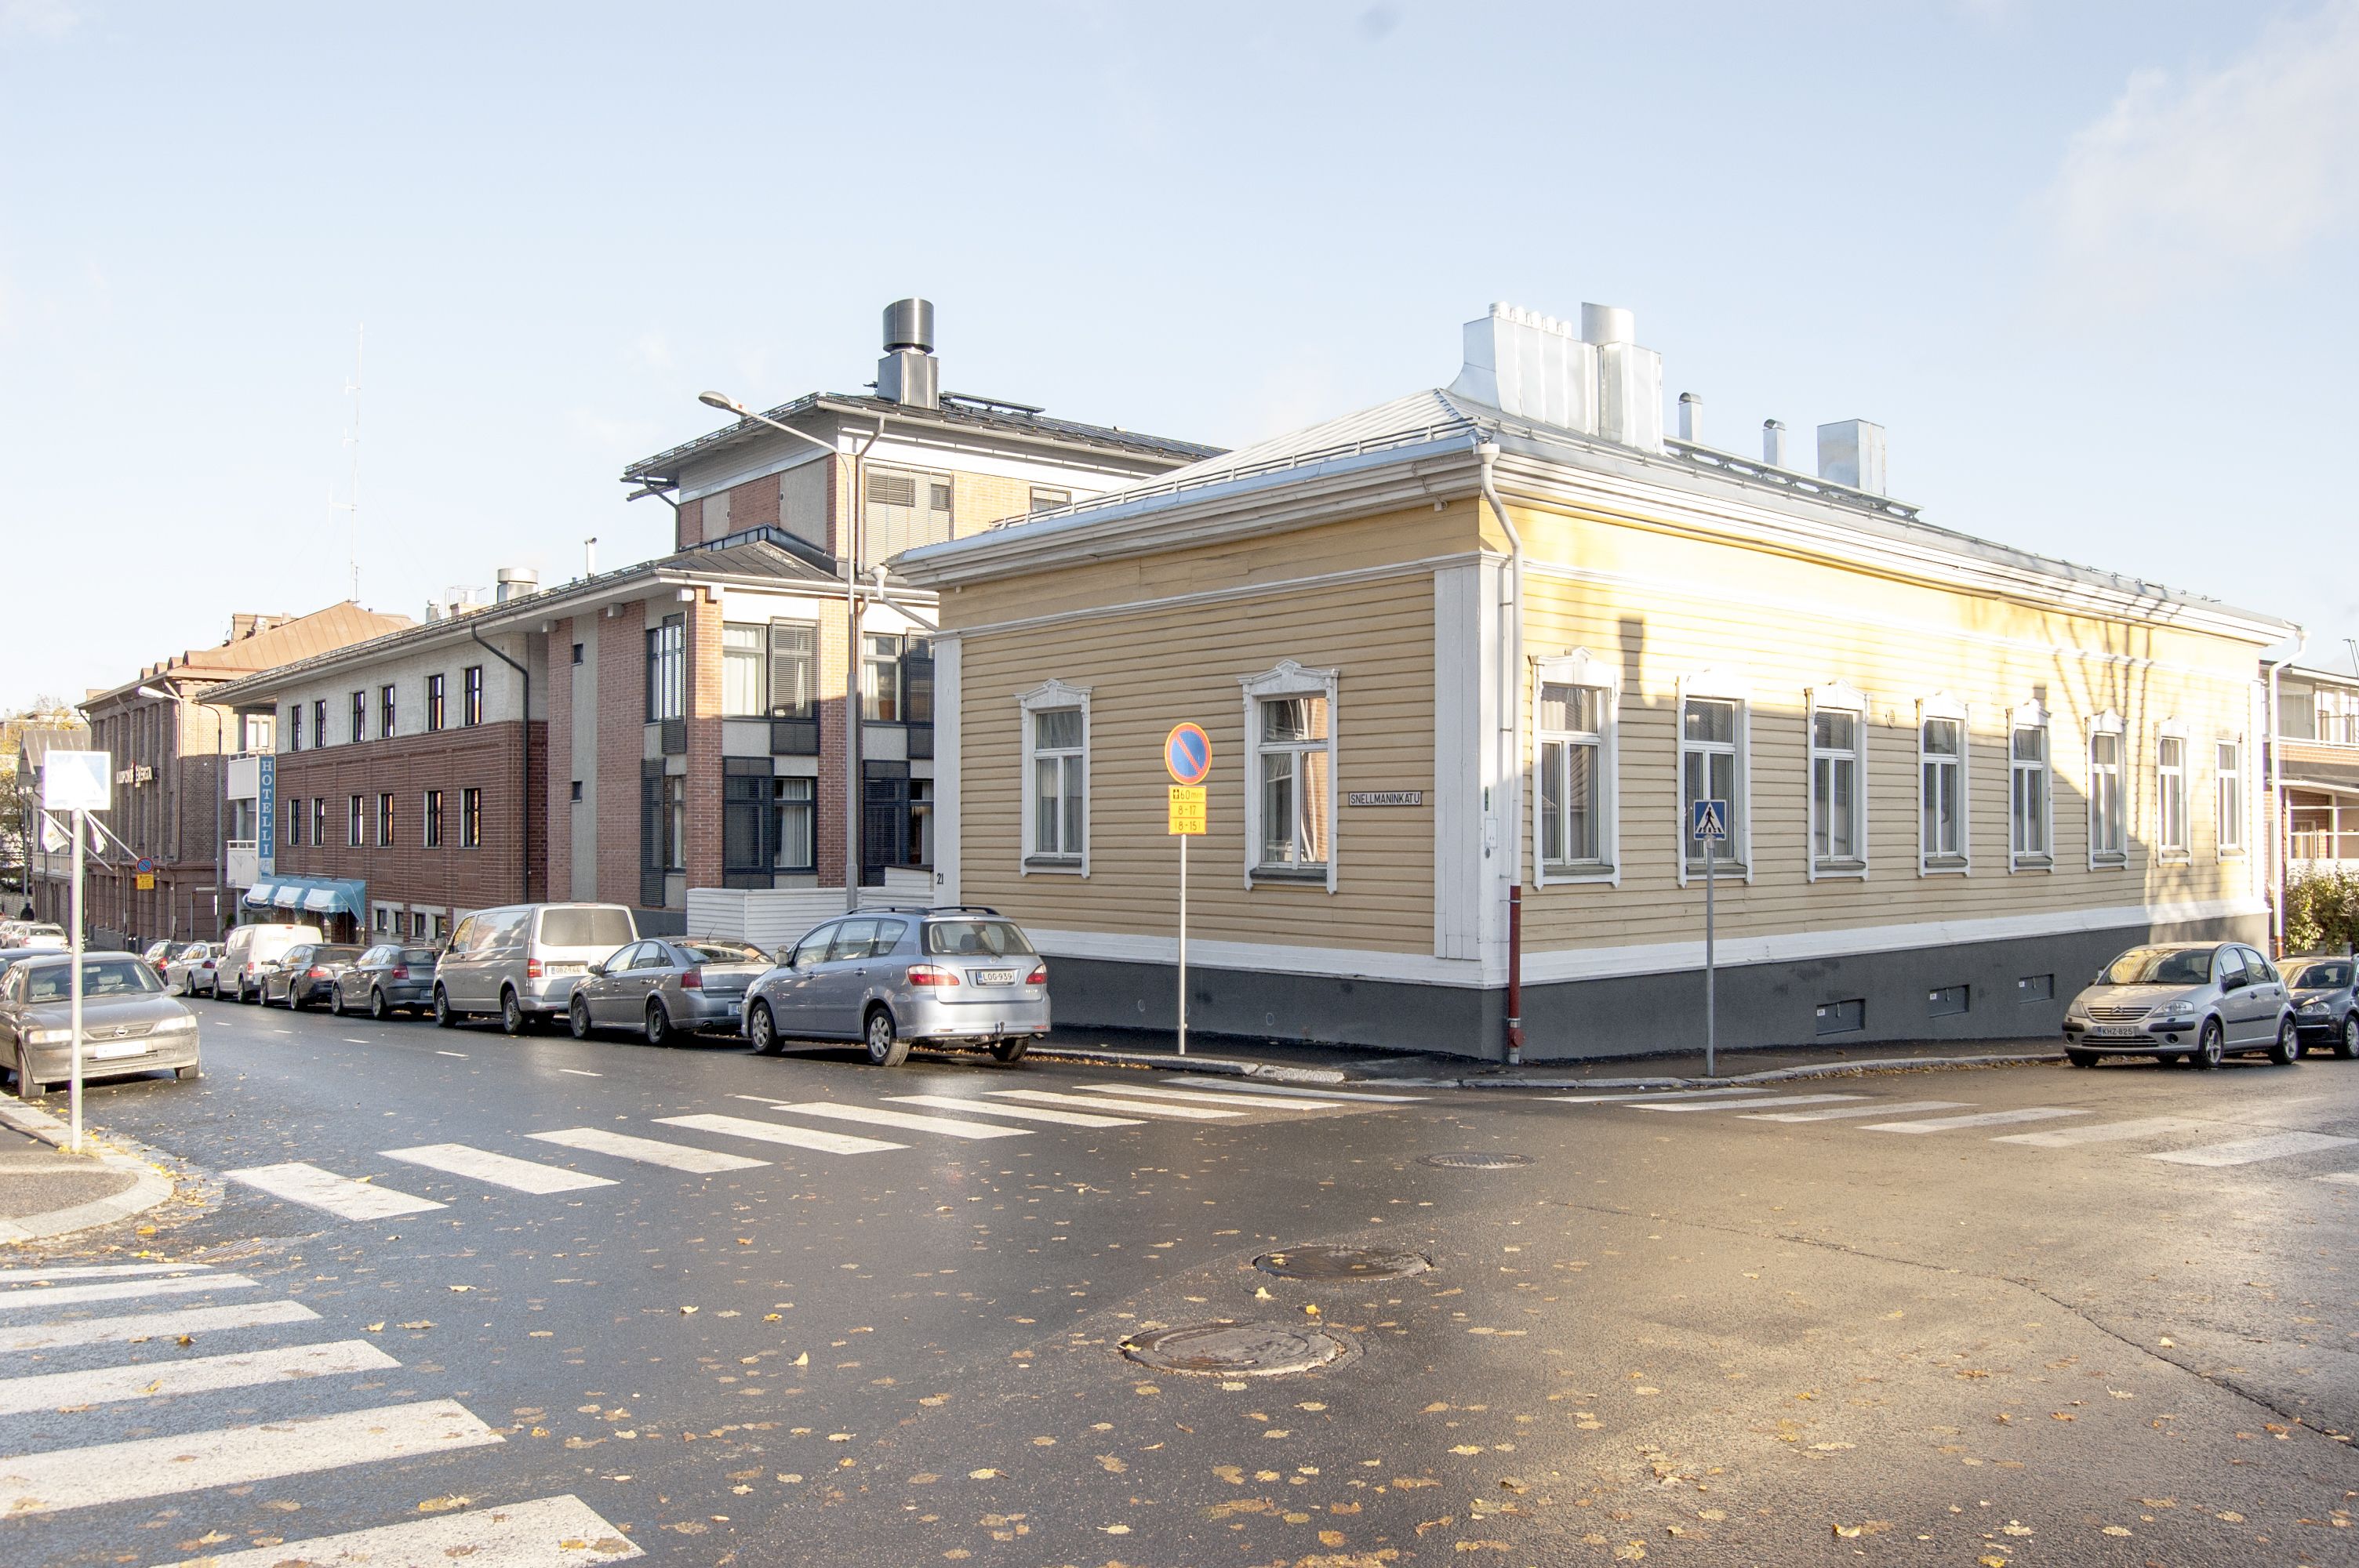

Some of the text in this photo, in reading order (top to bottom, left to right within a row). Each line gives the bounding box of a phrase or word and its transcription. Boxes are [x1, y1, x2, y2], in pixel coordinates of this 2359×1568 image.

[1180, 789, 1203, 800] 60 min
[1350, 793, 1420, 805] SNELLMANINKATU
[261, 760, 273, 855] HOTELLI
[936, 872, 944, 885] 21
